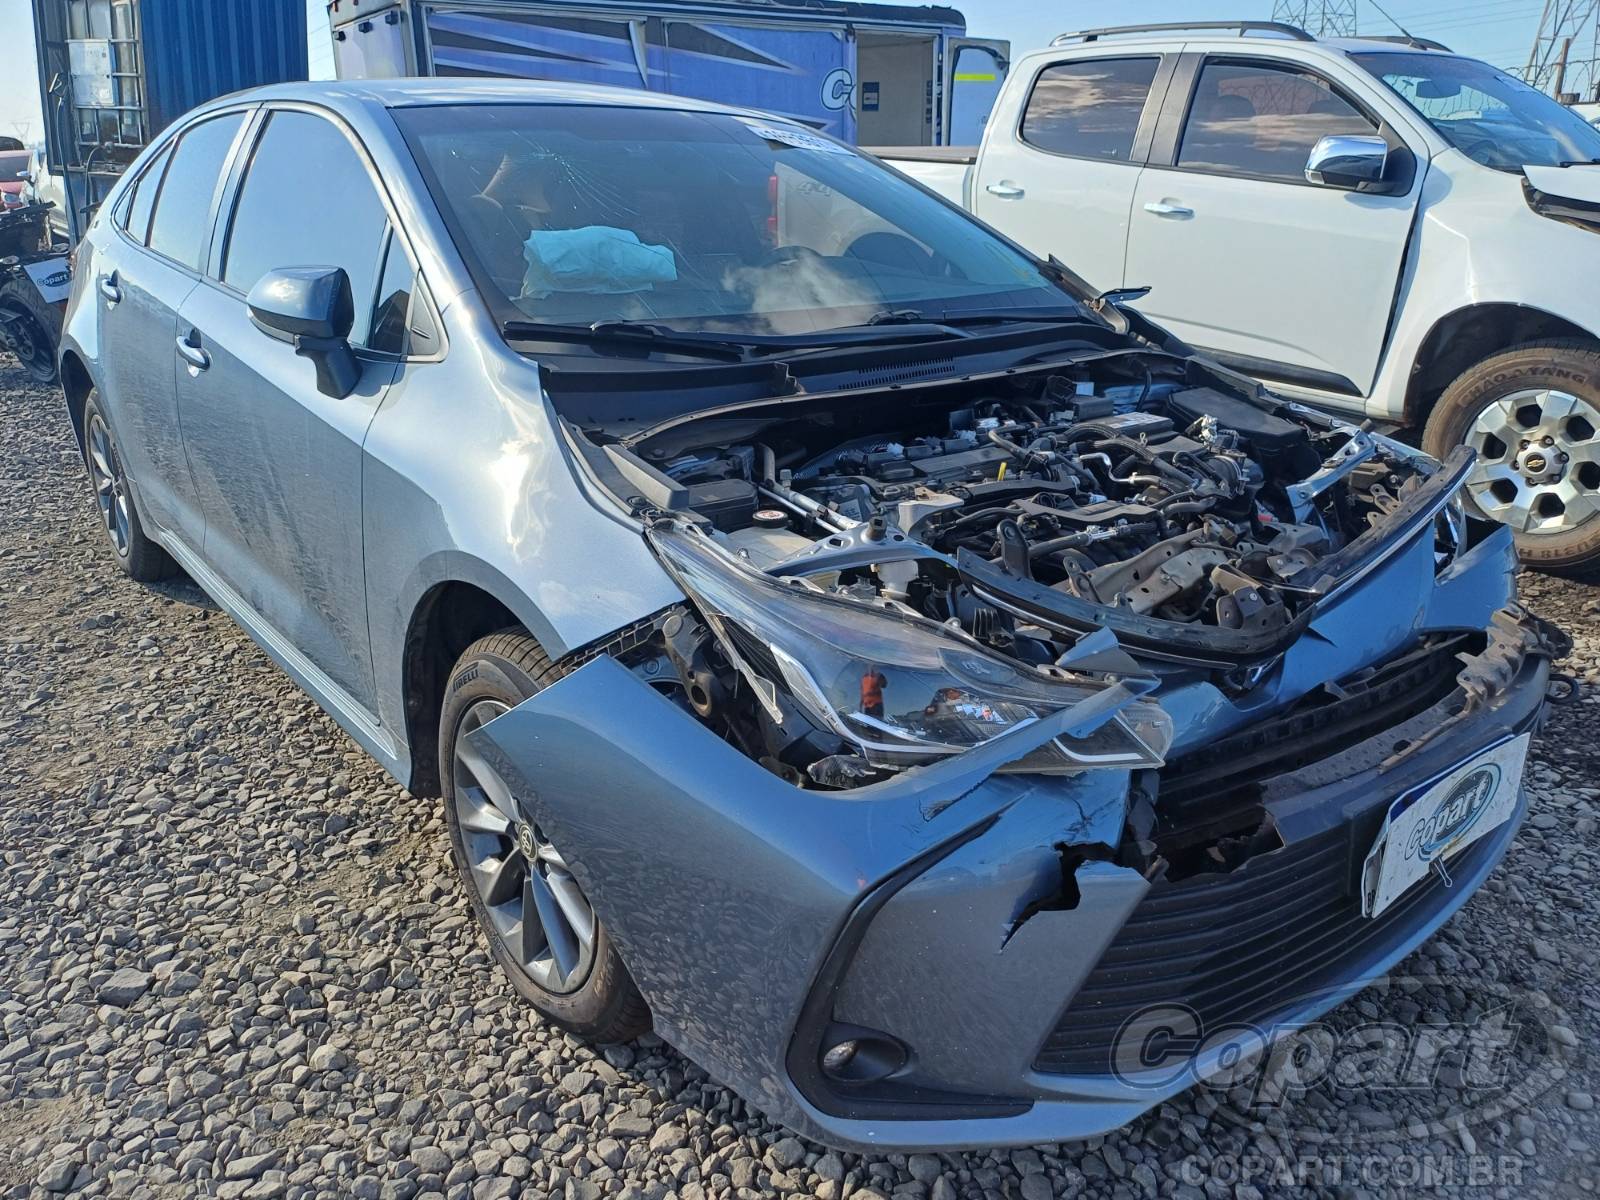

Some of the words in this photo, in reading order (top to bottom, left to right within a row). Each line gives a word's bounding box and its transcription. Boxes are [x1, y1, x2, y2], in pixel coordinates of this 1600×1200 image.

[37, 274, 68, 286] Copart
[452, 661, 480, 692] PIRELLI
[1404, 778, 1489, 860] Copart
